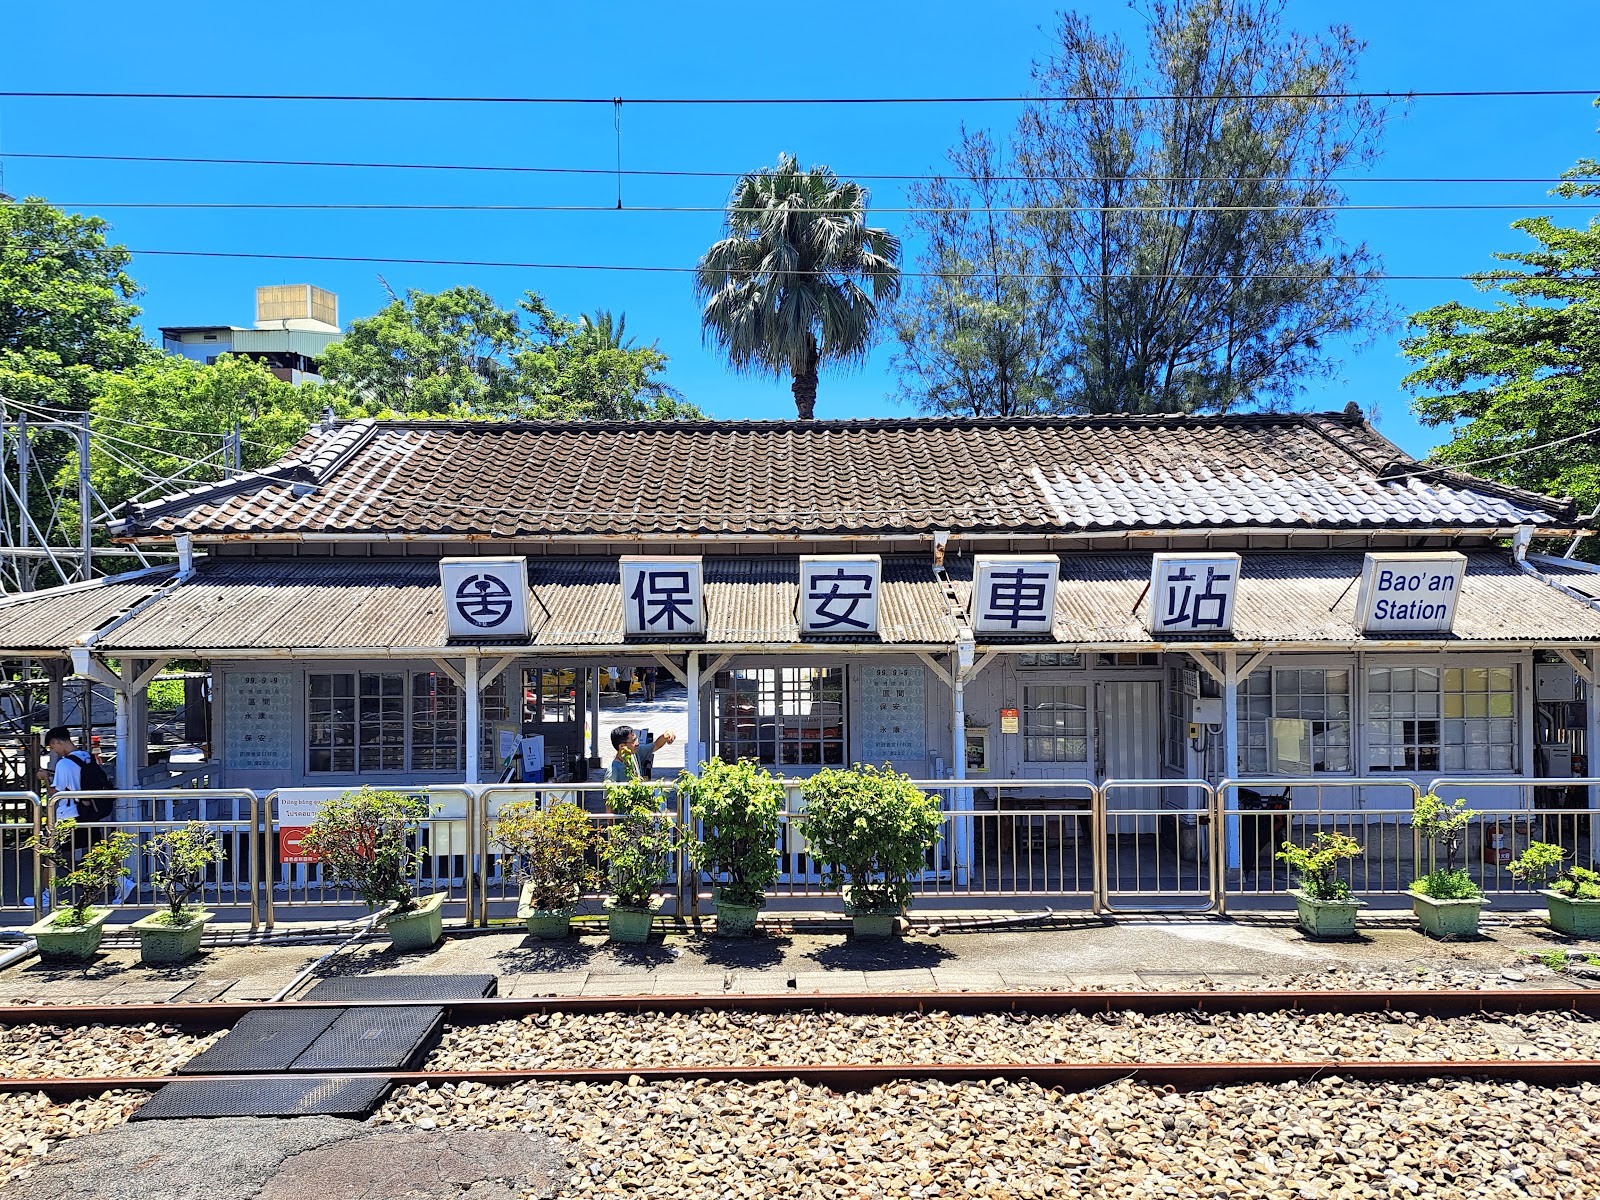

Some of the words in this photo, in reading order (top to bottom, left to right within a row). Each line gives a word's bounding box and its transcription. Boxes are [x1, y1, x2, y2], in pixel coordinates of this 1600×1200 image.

[631, 570, 695, 631] 保
[809, 569, 872, 628] 安
[984, 569, 1051, 631] 車
[1163, 567, 1230, 630] 站
[1374, 599, 1447, 620] Station
[1378, 570, 1455, 592] Bao'an
